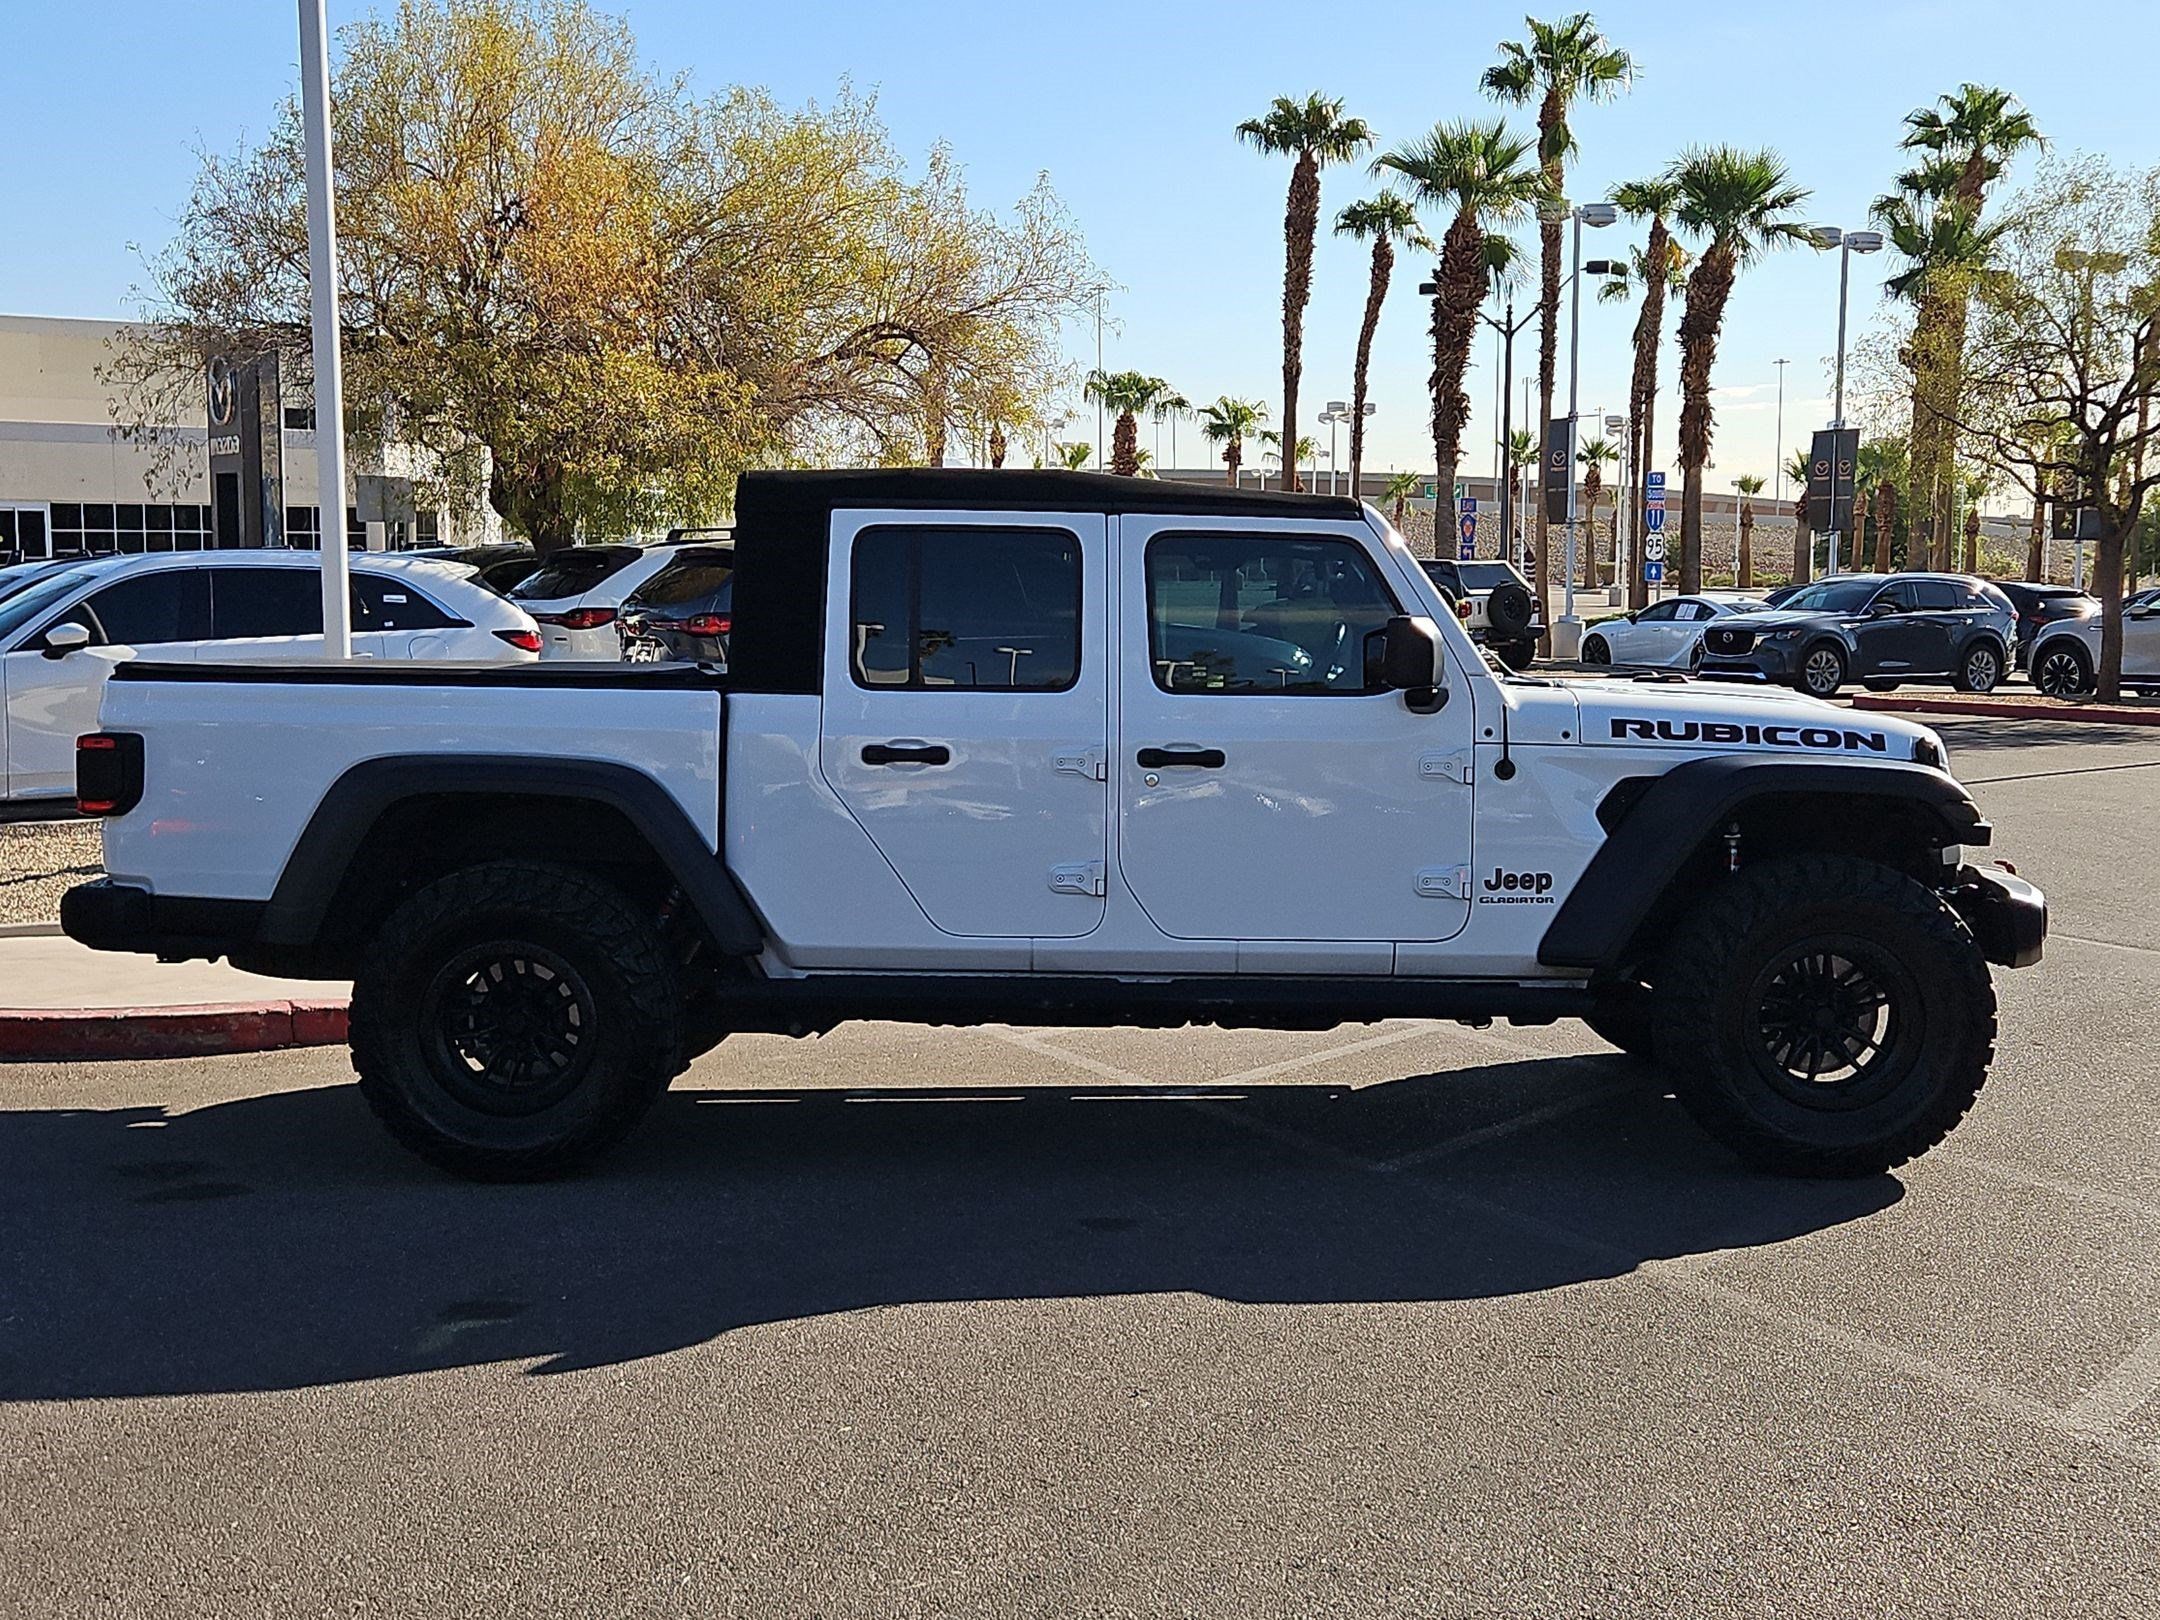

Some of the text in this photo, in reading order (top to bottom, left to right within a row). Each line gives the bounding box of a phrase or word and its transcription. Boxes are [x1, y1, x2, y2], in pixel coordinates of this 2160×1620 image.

[1652, 474, 1662, 483] TO
[1651, 510, 1660, 526] 11
[1647, 539, 1662, 555] 95
[1610, 718, 1887, 752] RUBICON
[1483, 867, 1553, 895] Jeep
[1478, 896, 1555, 904] GLADIATOR
